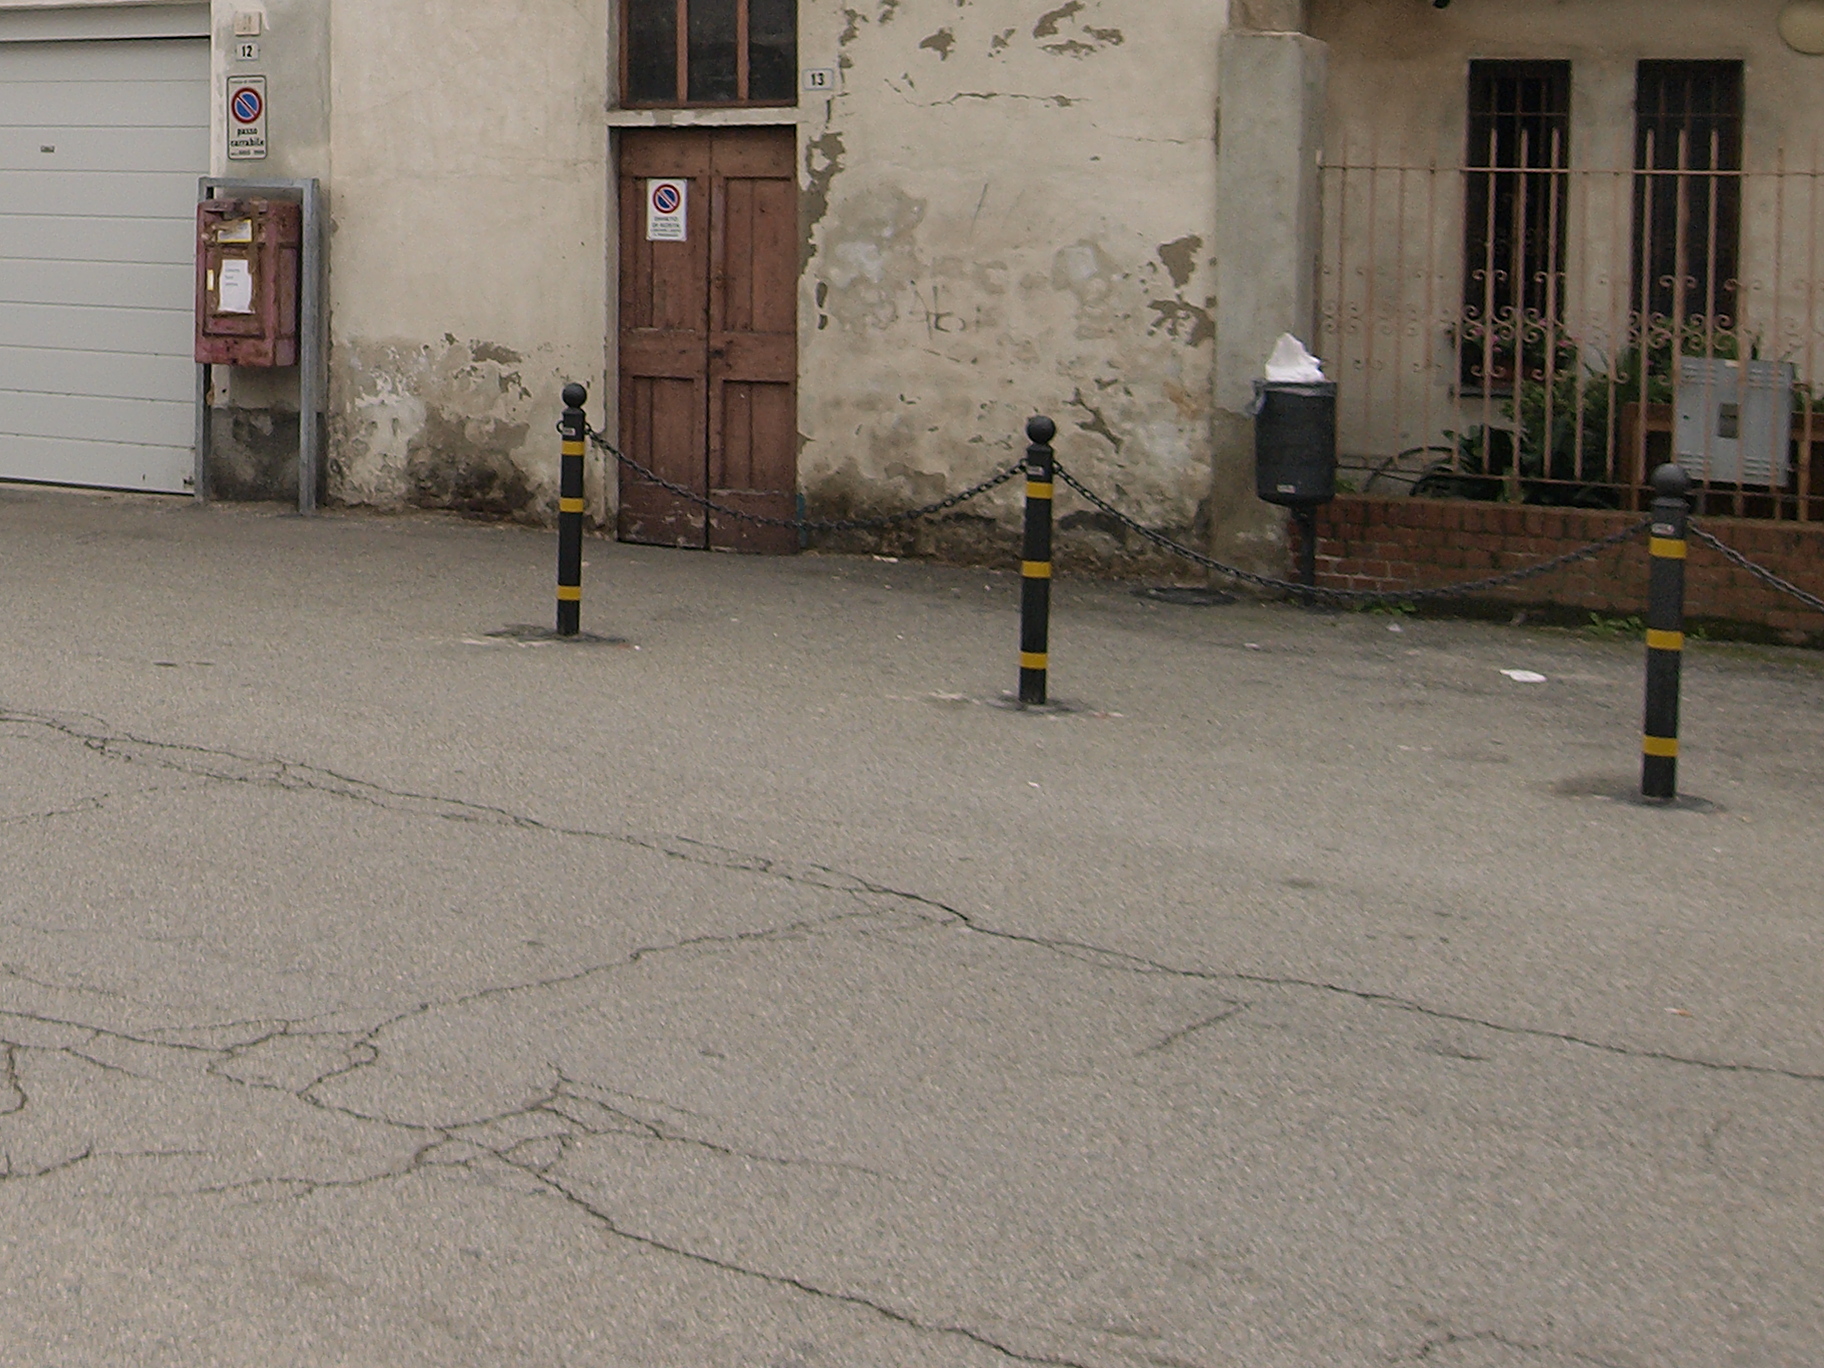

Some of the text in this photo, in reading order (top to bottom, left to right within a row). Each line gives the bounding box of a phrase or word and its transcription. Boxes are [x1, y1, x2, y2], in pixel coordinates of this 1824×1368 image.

[241, 45, 252, 57] 12
[811, 72, 824, 86] 13
[237, 127, 258, 137] passo
[230, 137, 265, 147] carrabile
